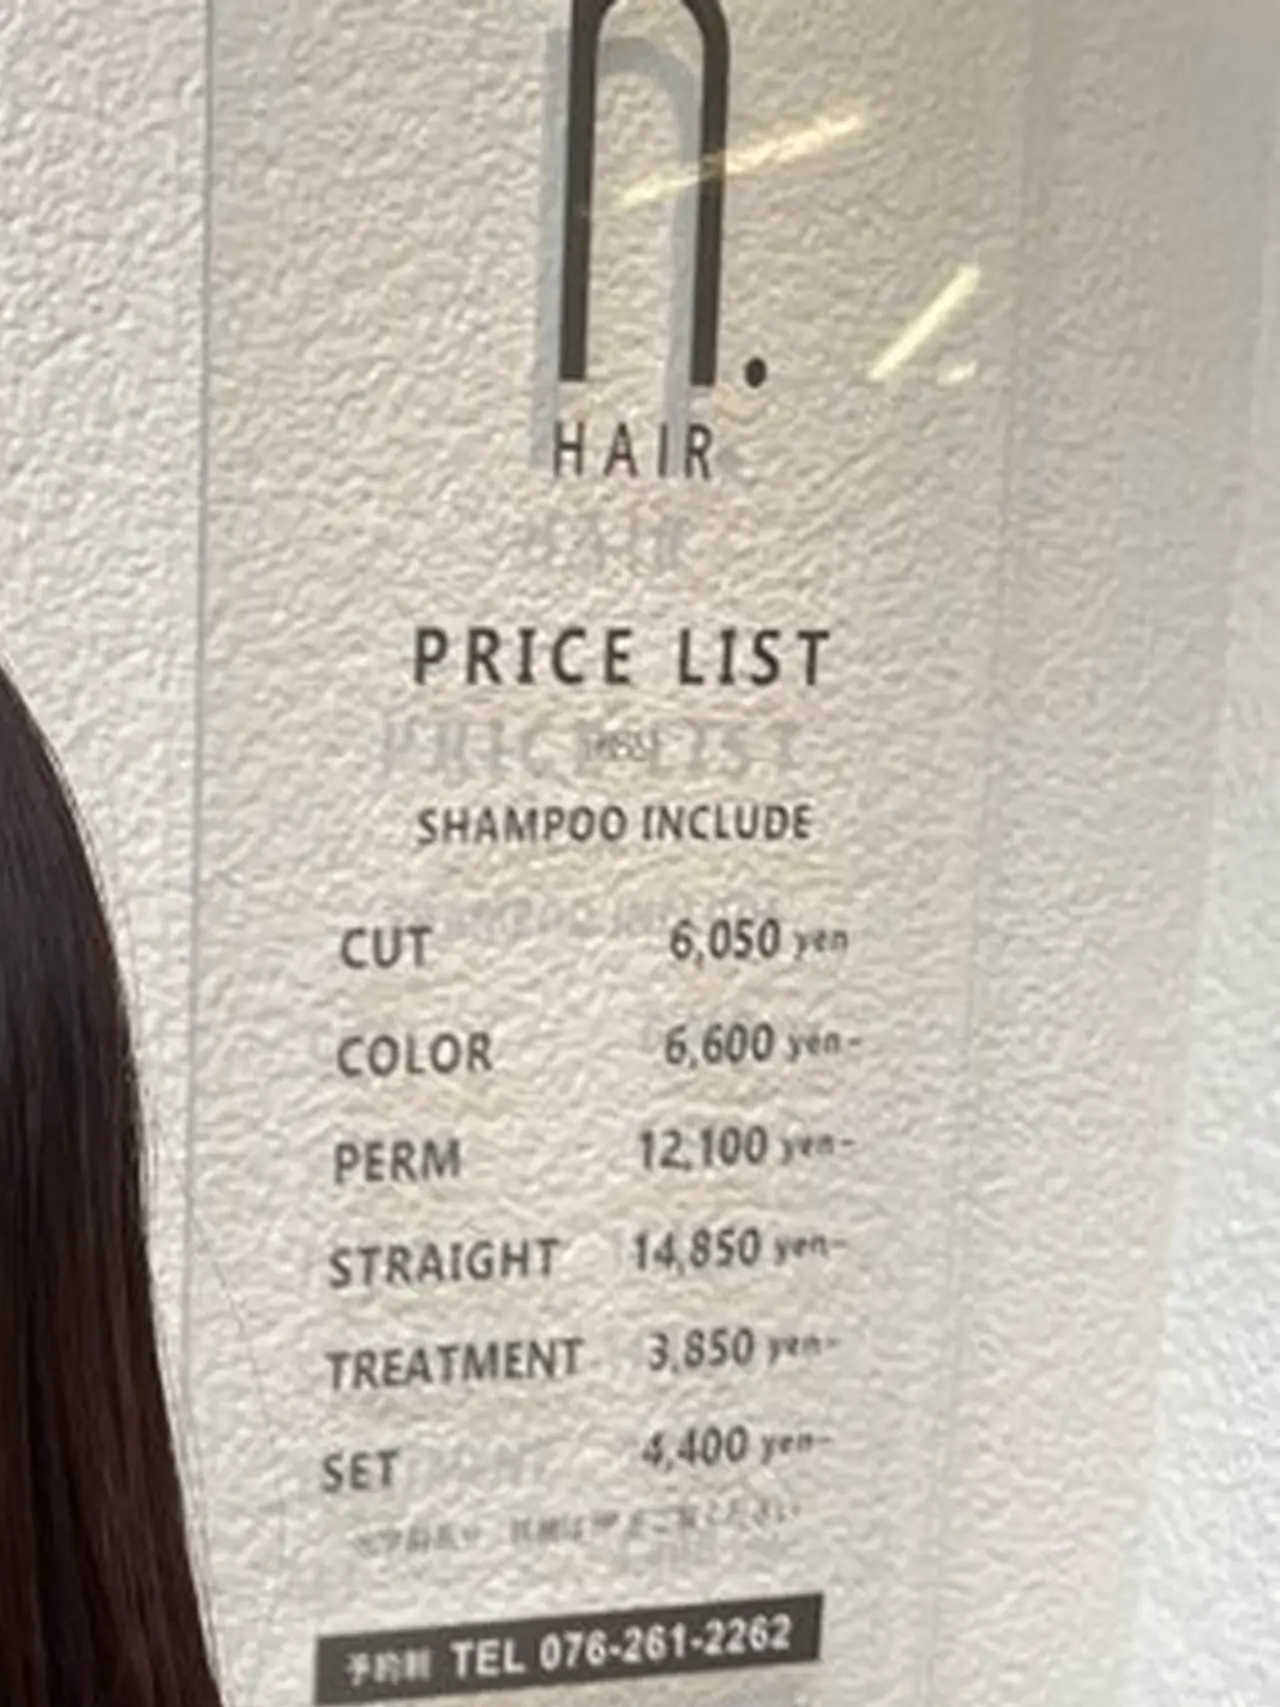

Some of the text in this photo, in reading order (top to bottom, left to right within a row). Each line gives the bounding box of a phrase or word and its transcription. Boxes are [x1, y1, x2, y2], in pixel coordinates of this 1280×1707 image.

[552, 422, 716, 480] HAIR
[412, 626, 832, 687] PRICE LIST
[416, 803, 814, 846] SHAMPOO INCLUDE
[340, 926, 434, 970] CUT
[669, 917, 781, 969] 6,050
[337, 1032, 493, 1077] COLOR
[664, 1022, 775, 1070] 6,600
[333, 1138, 462, 1185] PERM
[639, 1126, 769, 1174] 12,100
[328, 1237, 560, 1289] STRAIGHT
[634, 1227, 762, 1275] 14,850
[326, 1337, 584, 1391] TREATMENT
[648, 1327, 755, 1375] 3,850
[321, 1448, 400, 1494] SET
[642, 1426, 748, 1471] 4,400
[450, 1639, 526, 1678] TEL
[541, 1614, 793, 1671] 076-261-2262
